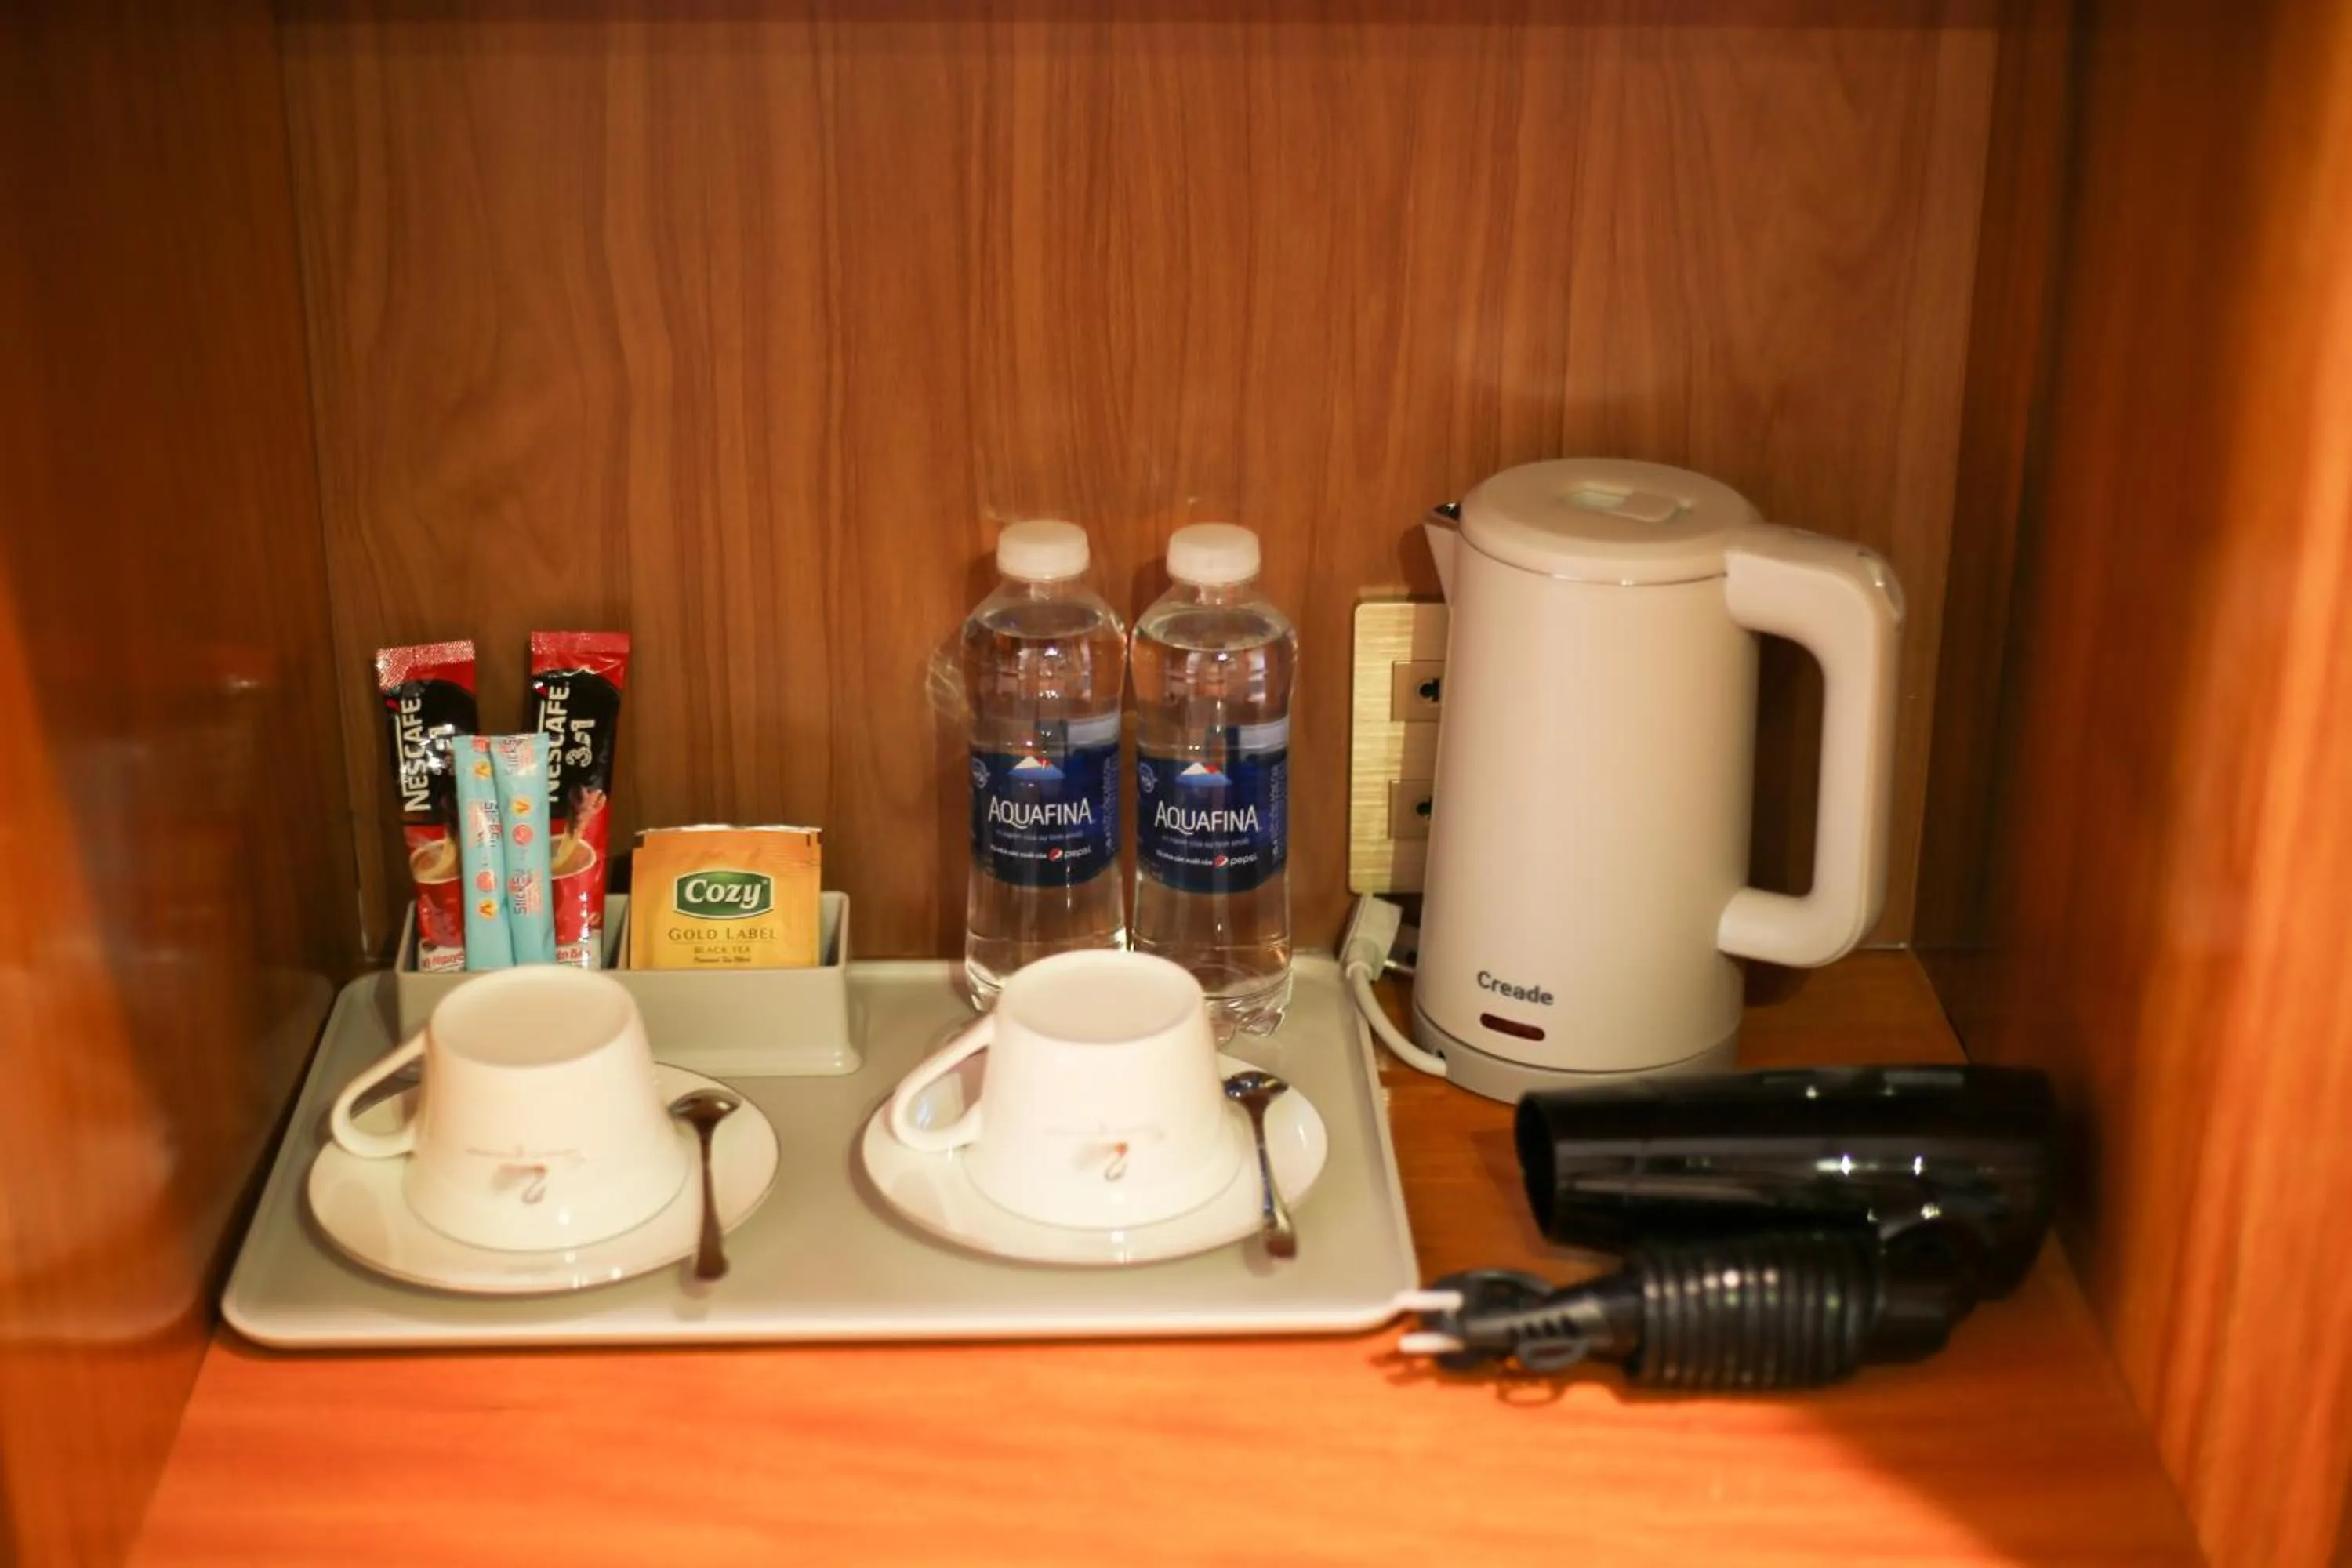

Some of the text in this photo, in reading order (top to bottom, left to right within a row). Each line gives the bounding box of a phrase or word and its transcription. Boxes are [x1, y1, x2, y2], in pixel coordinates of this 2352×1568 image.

[988, 796, 1092, 830] AQUAFINA
[1154, 800, 1259, 836] AQUAFINA
[1064, 846, 1092, 860] pepsi
[1229, 853, 1258, 866] pepsi
[684, 878, 763, 909] Cozy
[668, 927, 778, 941] GOLD LABEL
[1477, 971, 1554, 1005] Creade
